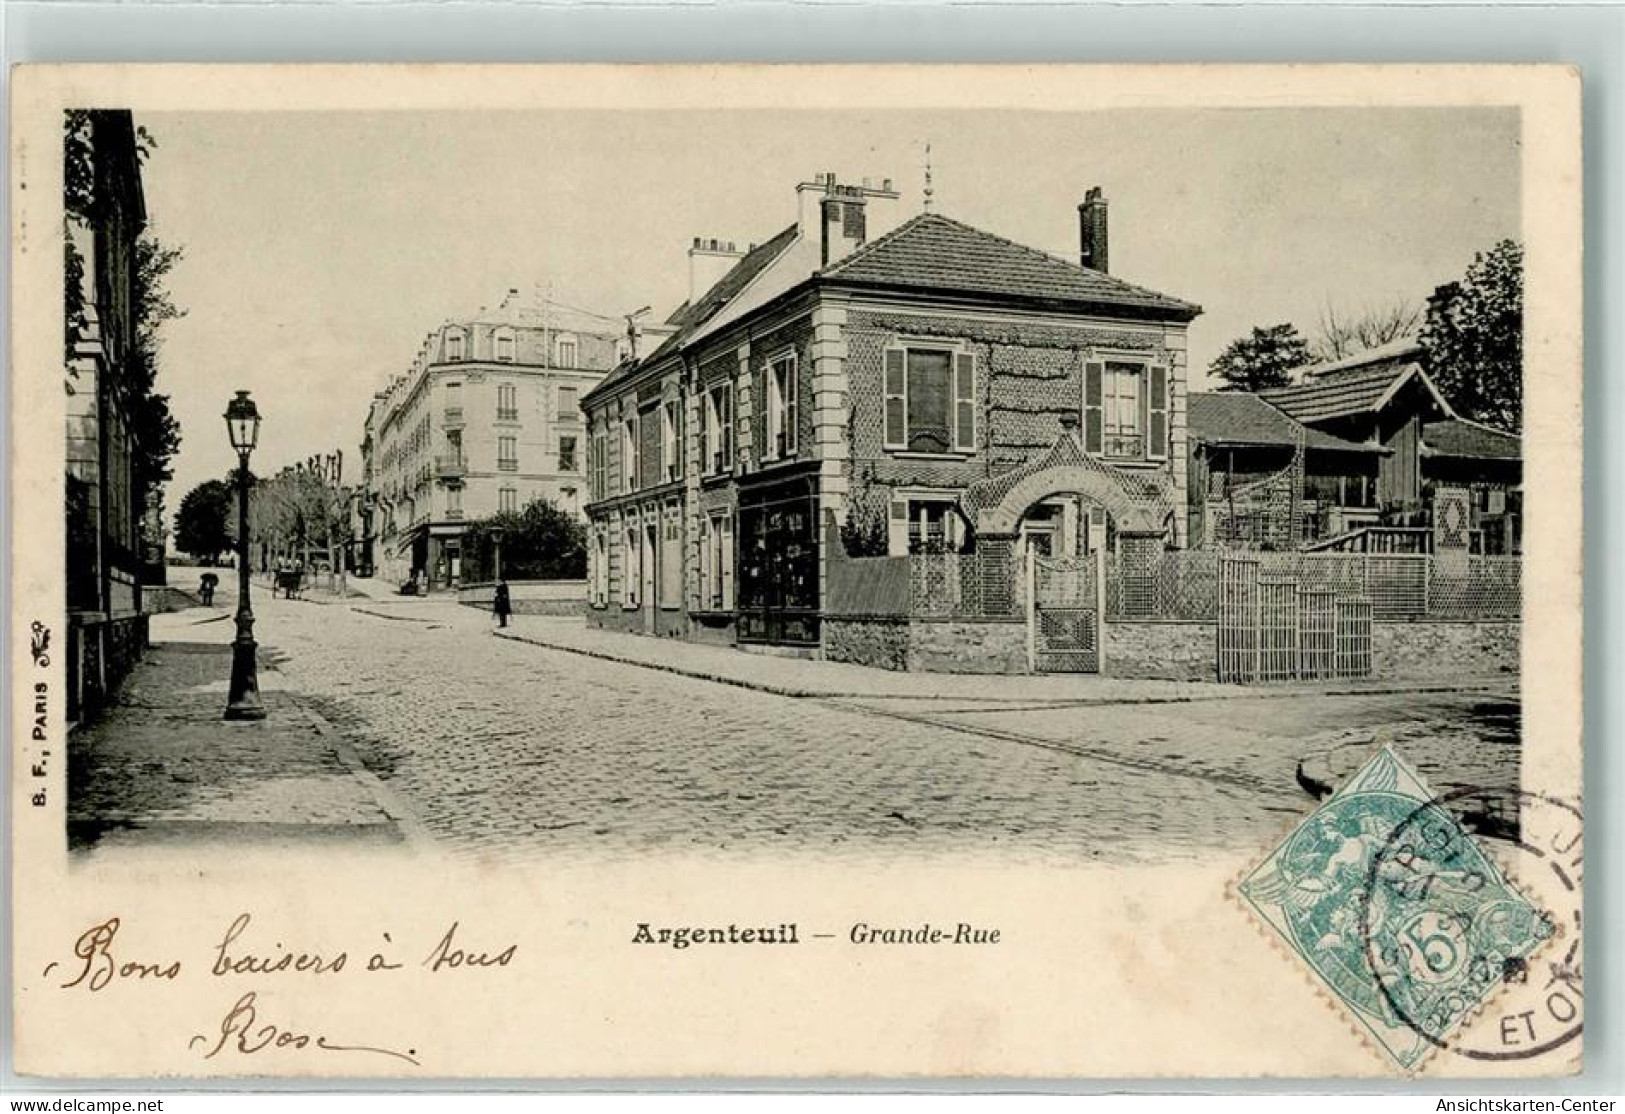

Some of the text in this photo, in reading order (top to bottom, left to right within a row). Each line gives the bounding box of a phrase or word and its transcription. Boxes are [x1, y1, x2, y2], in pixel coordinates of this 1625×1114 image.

[31, 682, 50, 741] PARIS
[50, 913, 518, 992] Bons baisers à tous
[631, 923, 799, 950] Argenteuil
[850, 922, 1001, 945] Grande-Rue
[1500, 1010, 1536, 1045] ET
